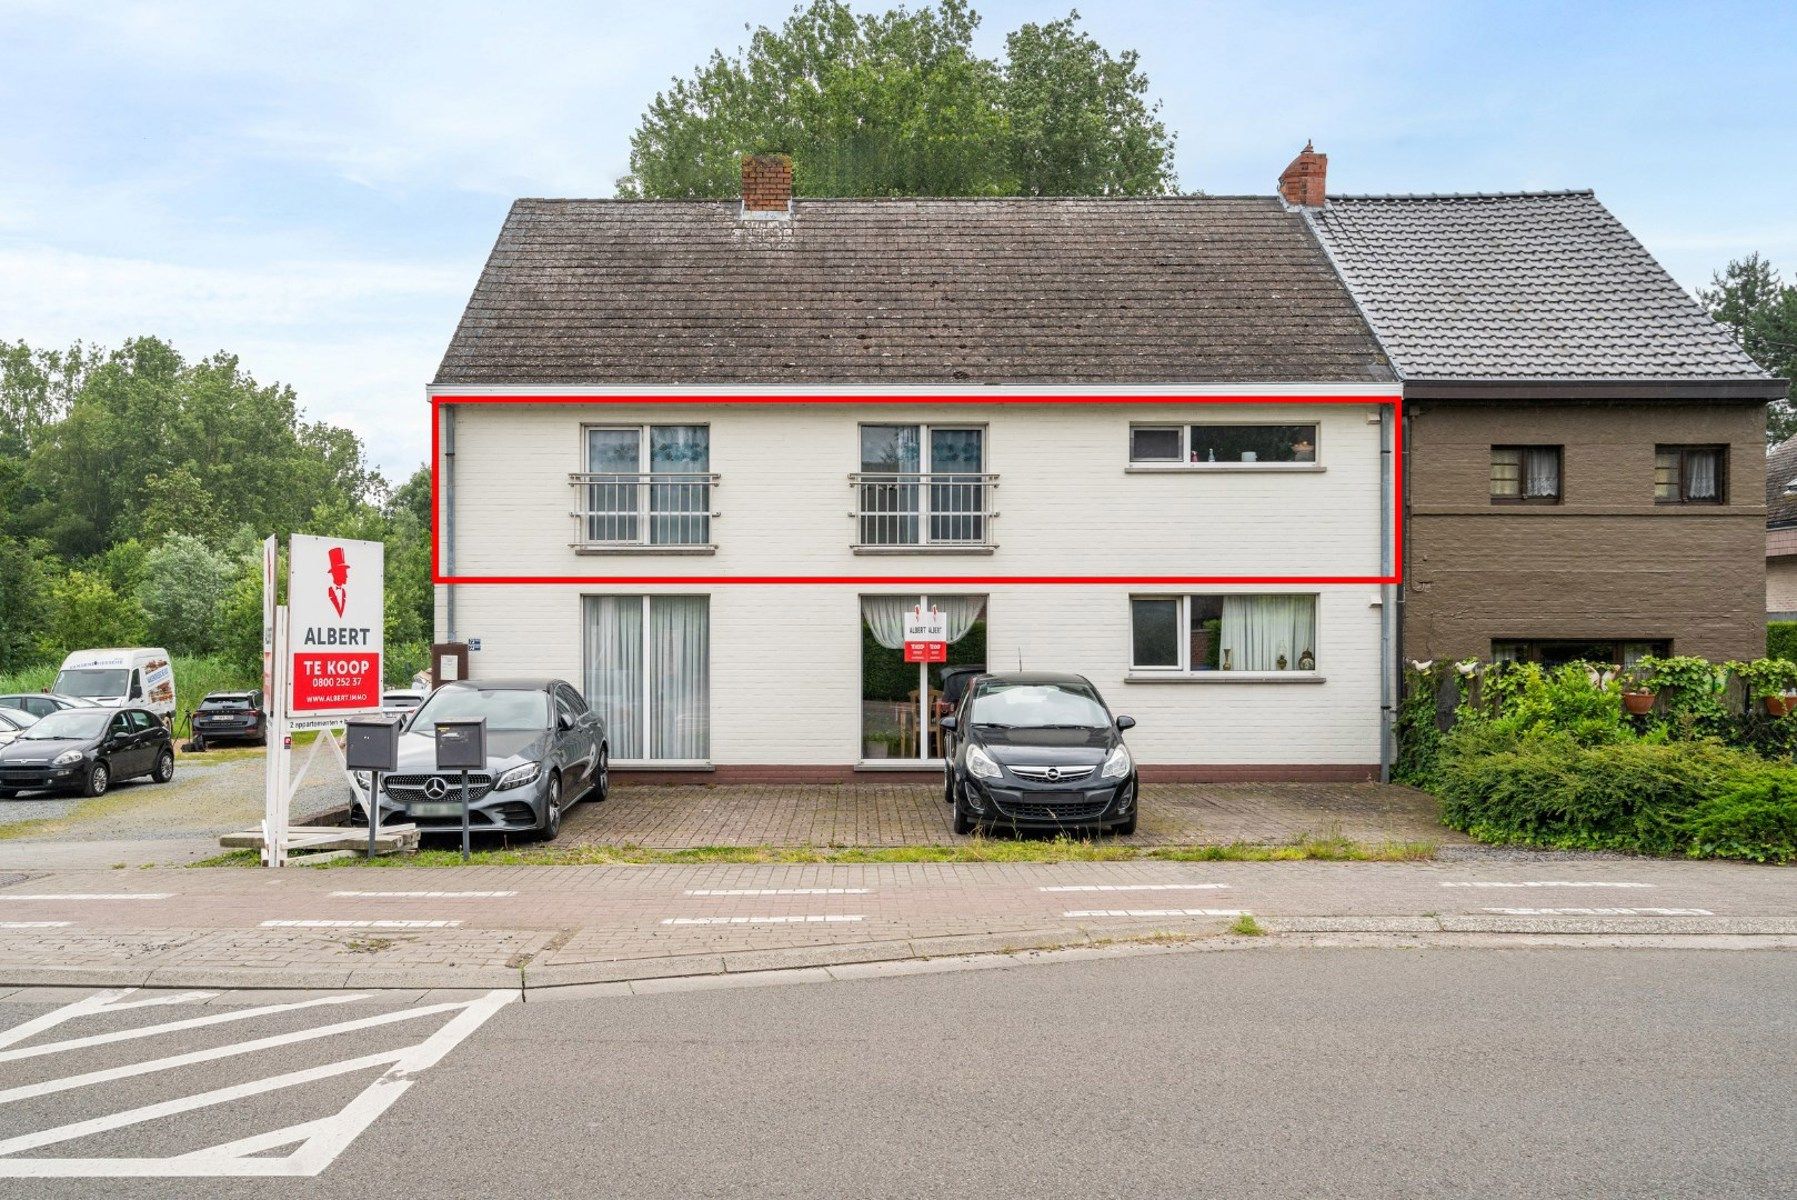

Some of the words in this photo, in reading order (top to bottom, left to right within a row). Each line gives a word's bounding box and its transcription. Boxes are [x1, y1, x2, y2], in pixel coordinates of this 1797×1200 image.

[304, 627, 370, 645] ALBERT
[304, 661, 321, 675] TE
[326, 660, 370, 675] KOOP
[312, 677, 334, 688] 0800
[336, 677, 350, 687] 252
[352, 677, 362, 686] 37
[306, 693, 368, 703] WWW.ALBERT.IMMO
[289, 721, 294, 729] 2
